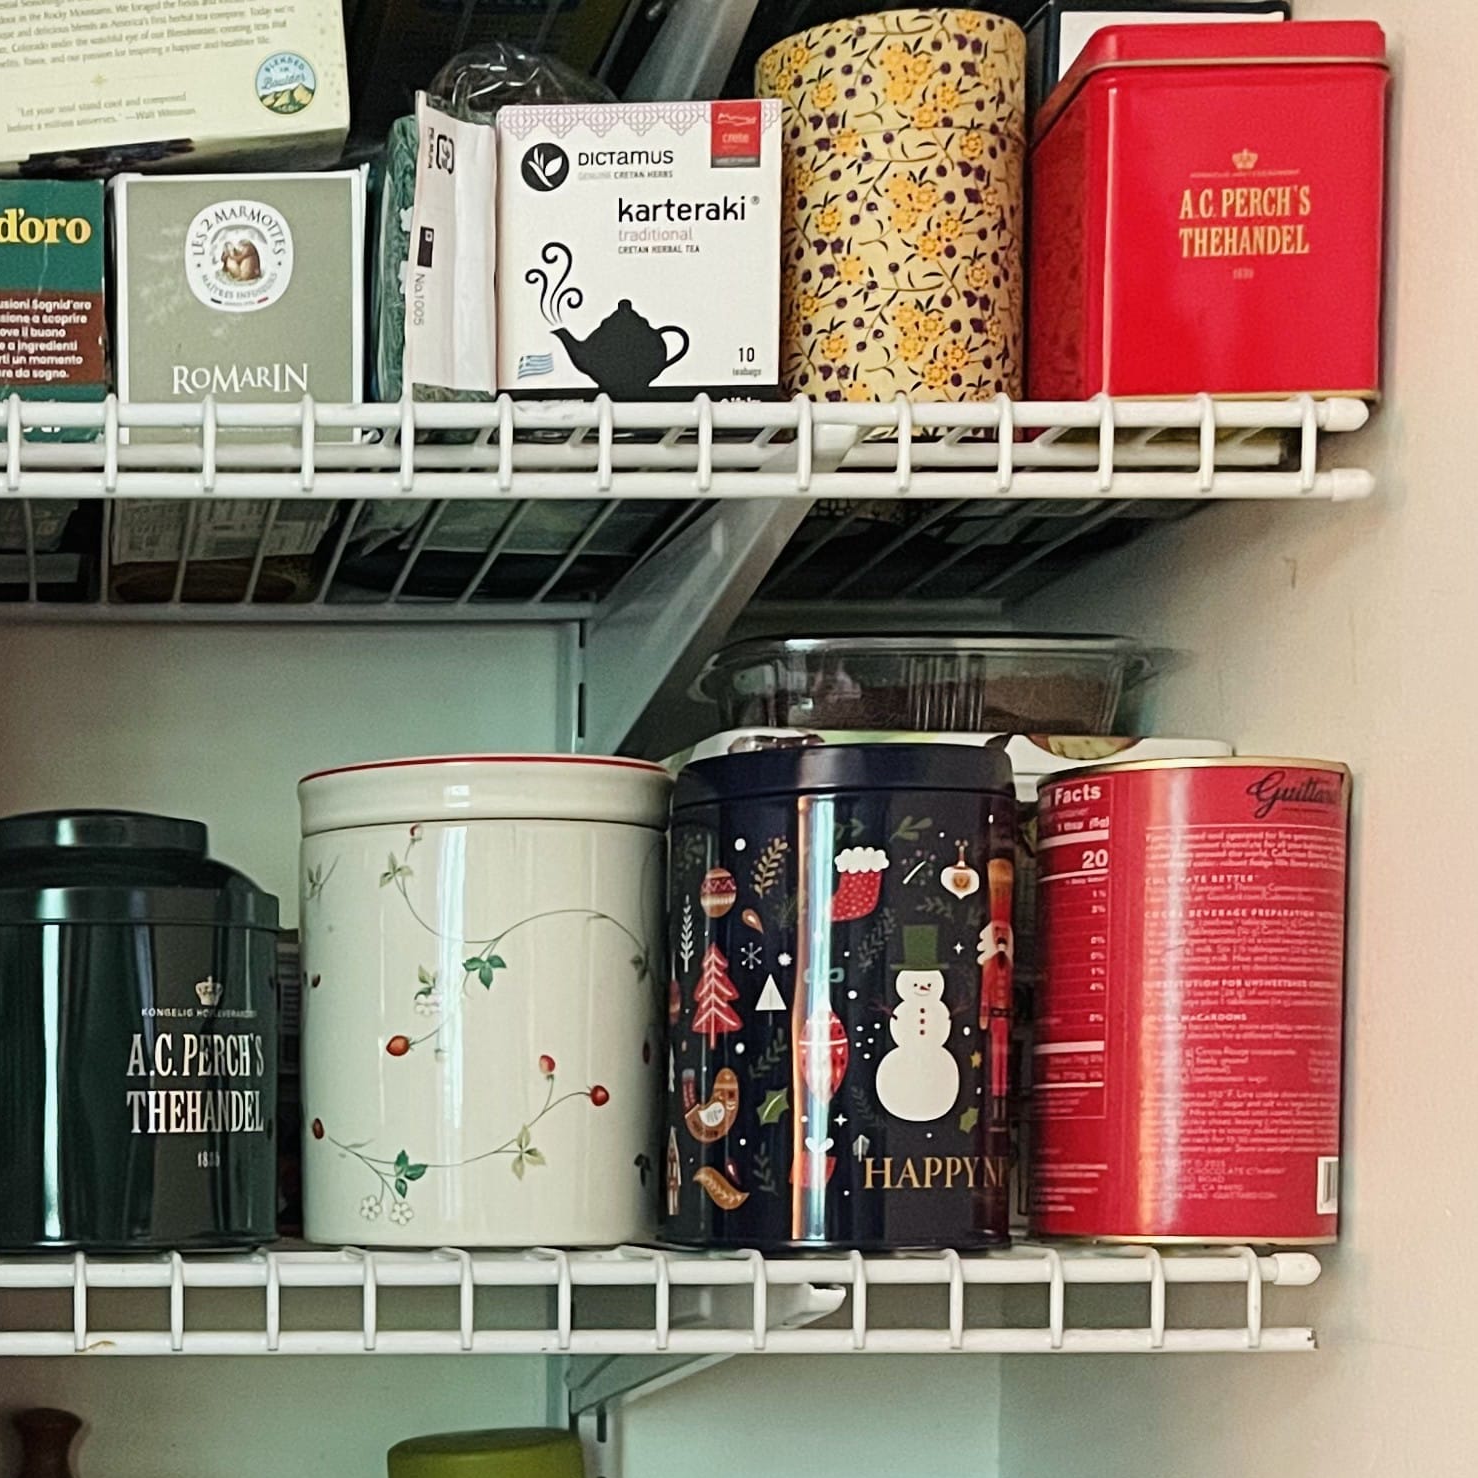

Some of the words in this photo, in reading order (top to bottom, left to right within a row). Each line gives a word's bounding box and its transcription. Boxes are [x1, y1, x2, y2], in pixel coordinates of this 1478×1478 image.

[618, 195, 746, 223] karteraki
[1222, 185, 1311, 218] PERCH'S
[191, 232, 208, 256] LES
[201, 219, 213, 231] 2
[214, 205, 286, 255] MARMOTTES
[618, 226, 693, 242] traditional
[618, 245, 649, 255] CRETAN
[651, 245, 683, 254] HERBAL
[685, 245, 700, 253] TEA
[1179, 224, 1310, 258] THEHANDEL
[42, 313, 88, 326] scoprire
[30, 327, 66, 338] buono
[17, 340, 78, 353] ingredienti
[737, 347, 756, 363] 10
[12, 356, 27, 364] un
[28, 355, 83, 365] momento
[32, 369, 70, 381] sogno.
[1054, 783, 1102, 807] Facts
[1081, 849, 1109, 869] 20
[141, 1008, 193, 1018] KONGELIG
[126, 1033, 177, 1077] A.C.
[182, 1033, 264, 1077] PERCH'S
[126, 1090, 264, 1133] THEHANDEL
[863, 1156, 979, 1189] HAPPY
